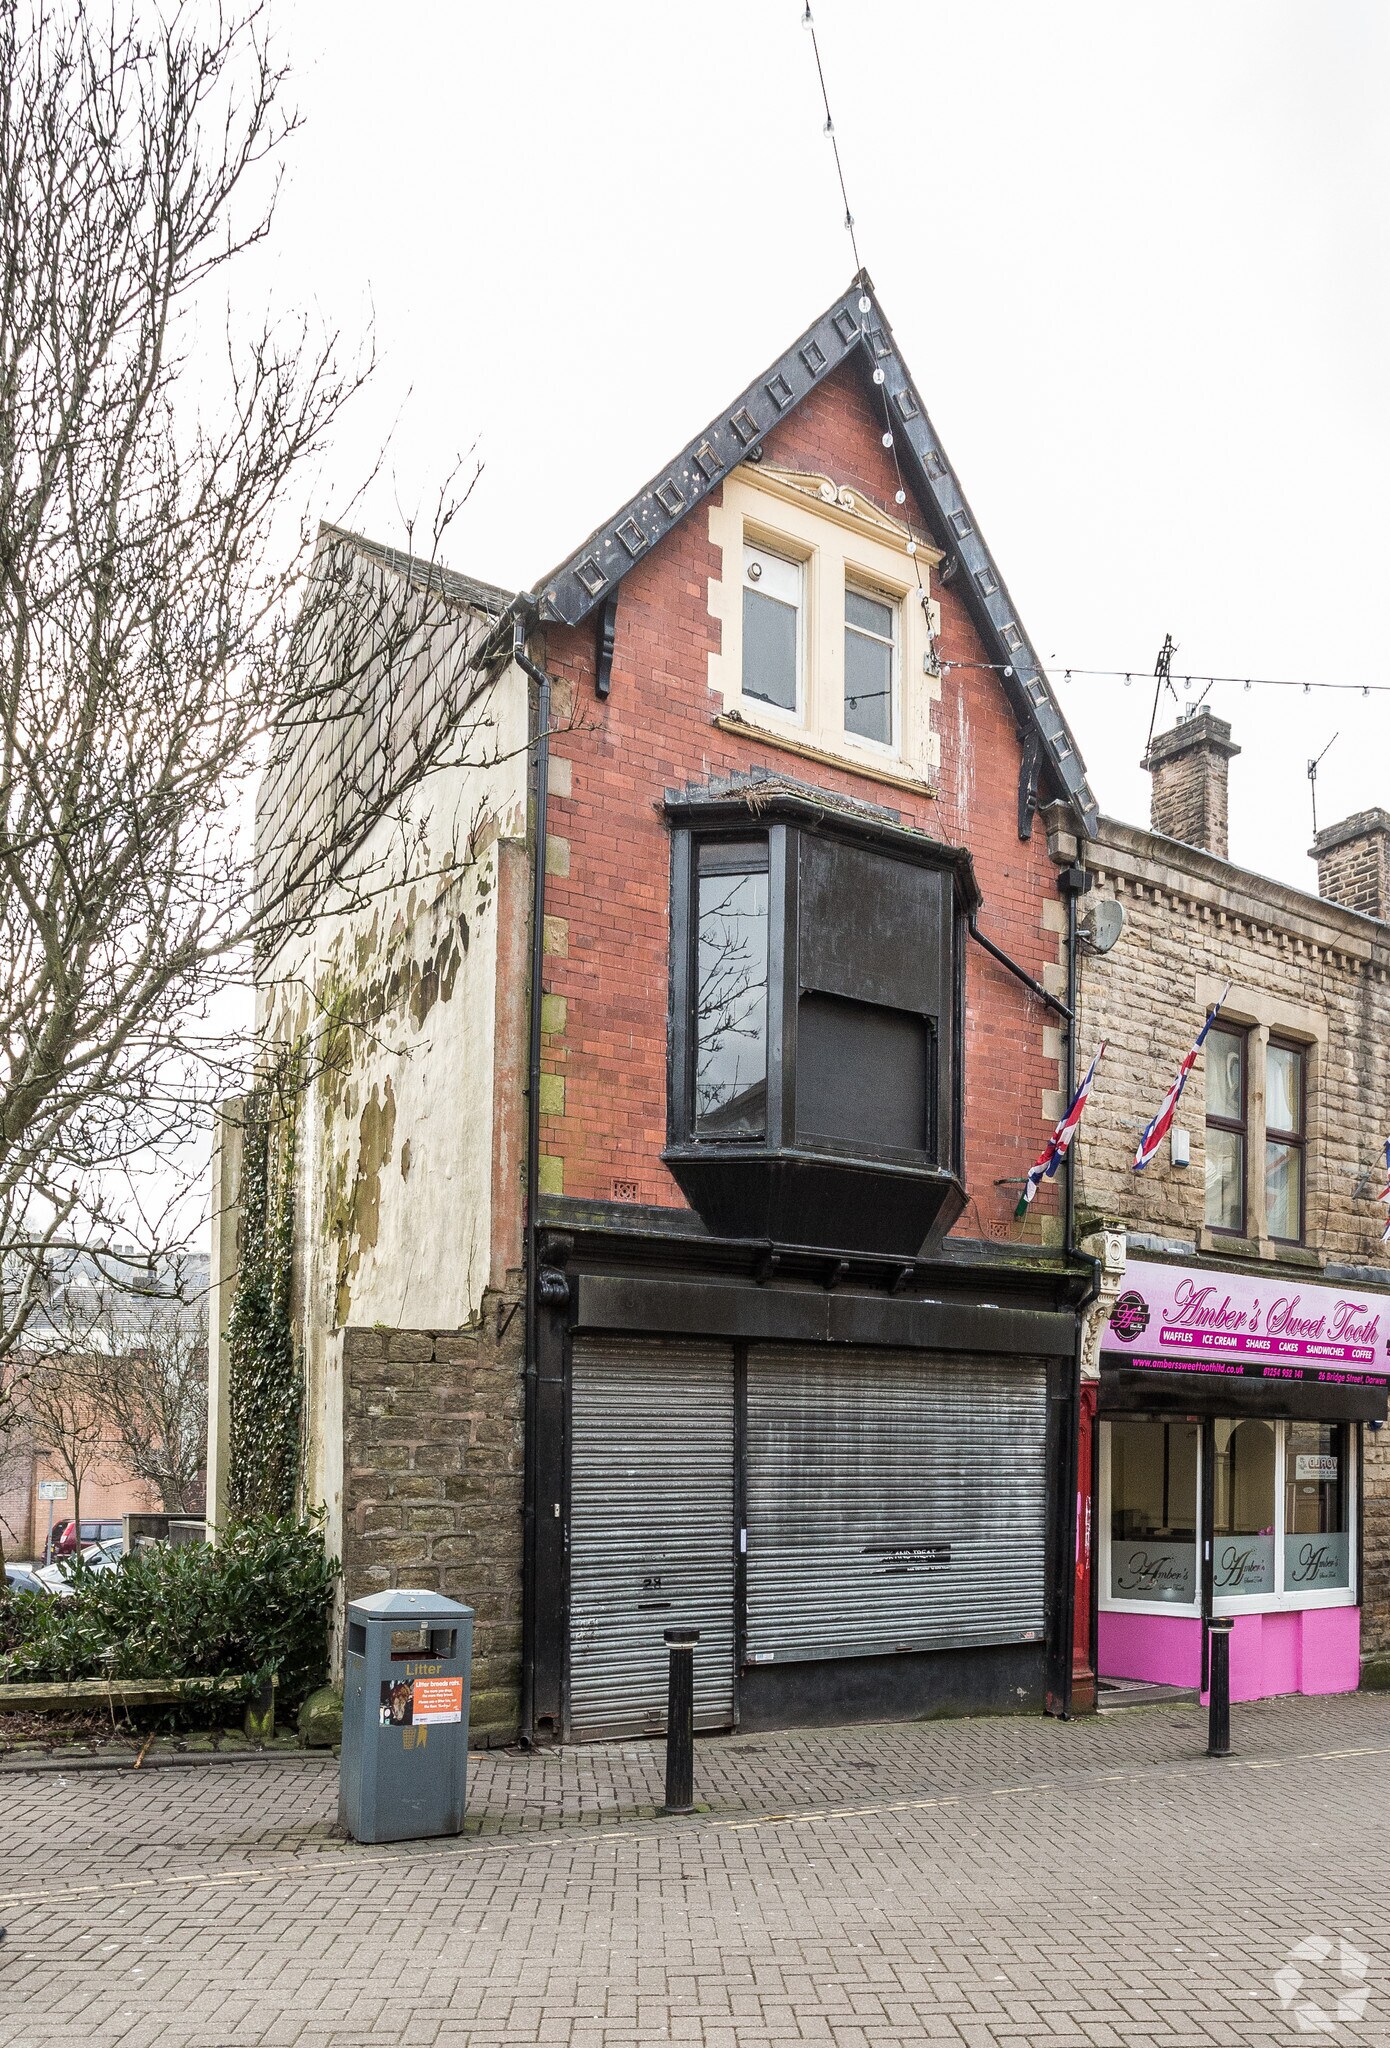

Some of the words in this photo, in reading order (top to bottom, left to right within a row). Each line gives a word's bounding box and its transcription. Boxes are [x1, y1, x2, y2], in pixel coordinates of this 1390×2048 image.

[1162, 1278, 1261, 1332] Amber's
[1266, 1295, 1326, 1339] Sweet
[1327, 1300, 1380, 1344] Tooth
[1163, 1330, 1194, 1343] WAFFLES
[1202, 1334, 1213, 1345] ICE
[1214, 1335, 1238, 1347] CREAM
[1245, 1339, 1271, 1350] SHAKES
[1278, 1341, 1299, 1353] CAKES
[1306, 1344, 1345, 1357] SANDWICHES
[1351, 1348, 1373, 1359] COFFEE
[1318, 1371, 1326, 1380] 26
[1326, 1372, 1345, 1385] Bridge
[1117, 1551, 1189, 1591] Amber's
[405, 1663, 442, 1676] Litter
